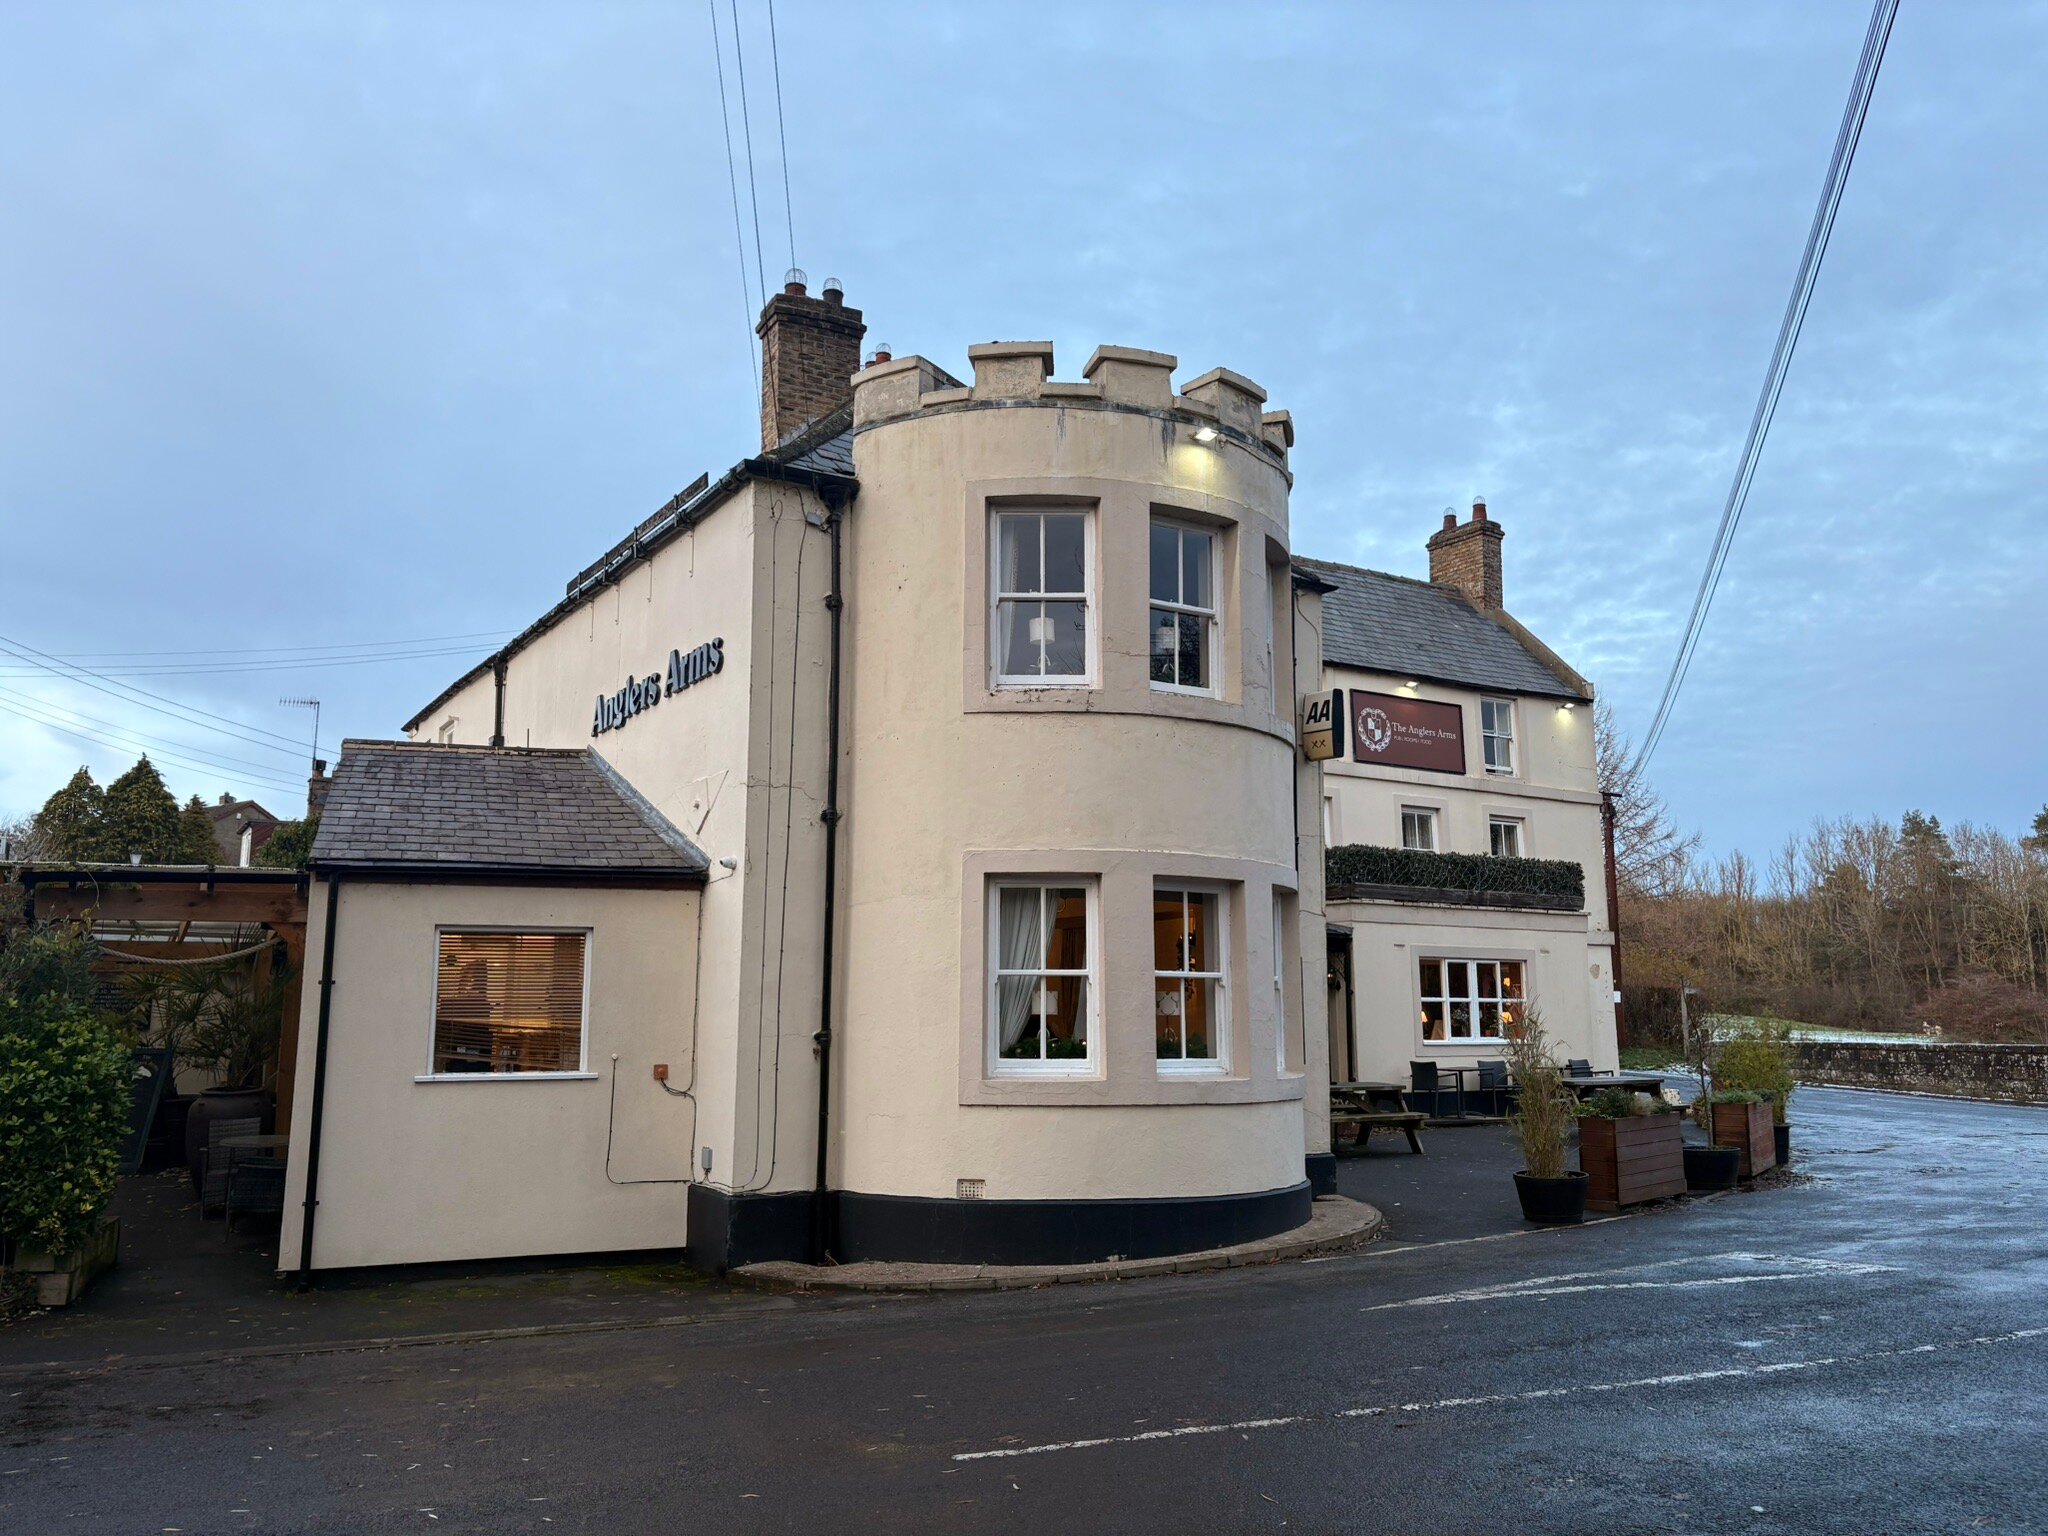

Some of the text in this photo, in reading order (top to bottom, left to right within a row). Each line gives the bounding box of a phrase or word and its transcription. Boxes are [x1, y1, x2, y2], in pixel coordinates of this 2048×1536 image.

[591, 637, 724, 737] Anglers Arms
[1305, 700, 1331, 725] AA
[1391, 721, 1457, 740] The Anglers Arms
